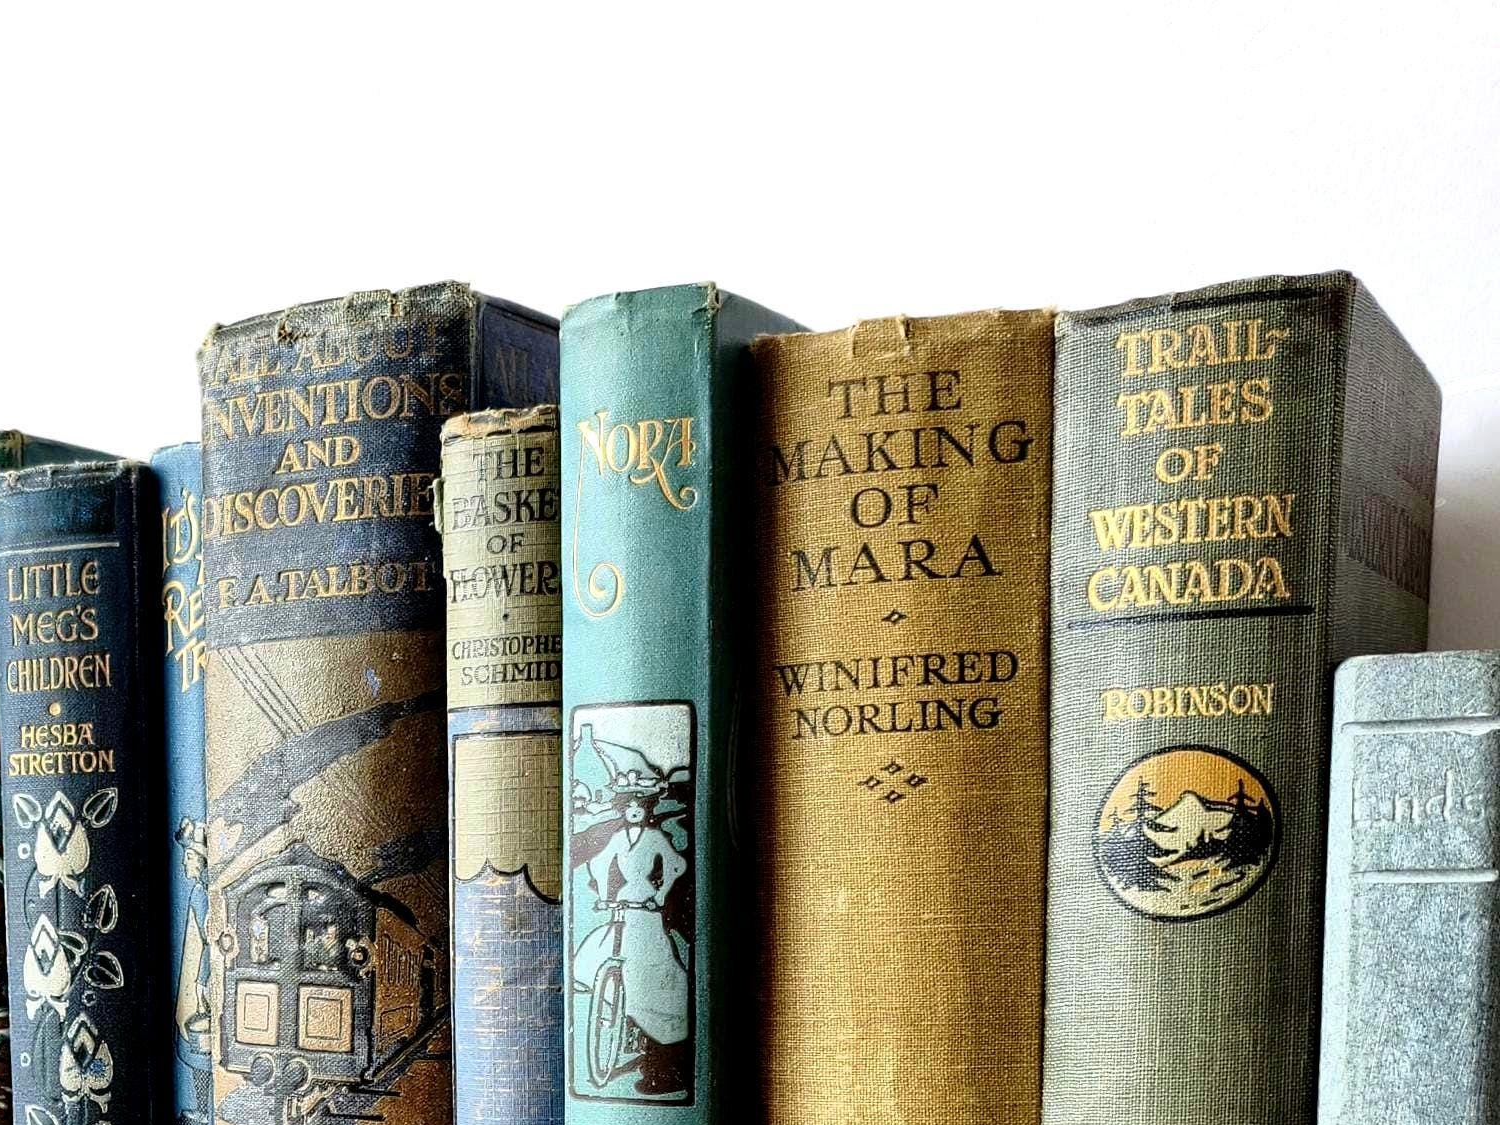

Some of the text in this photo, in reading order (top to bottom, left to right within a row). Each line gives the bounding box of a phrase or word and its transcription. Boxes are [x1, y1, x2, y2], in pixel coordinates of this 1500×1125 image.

[207, 372, 467, 444] NVENTIONS
[827, 369, 963, 420] THE
[1116, 378, 1274, 438] TALES
[274, 435, 362, 476] AND
[472, 446, 545, 483] THE
[770, 419, 1035, 487] MAKING
[1154, 442, 1223, 485] OF
[202, 472, 436, 541] DISCOVERIE
[451, 488, 559, 531] BASKE
[850, 483, 940, 530] OF
[1088, 493, 1296, 553] WESTERN
[485, 532, 526, 556] OF
[791, 534, 1001, 593] MARA
[6, 560, 101, 603] LITTLE
[449, 560, 560, 604] FLOWER
[1087, 555, 1291, 612] CANADA
[11, 604, 100, 648] MEG'S
[451, 633, 562, 661] CHRISTOPHE
[6, 653, 113, 693] CHILDREN
[460, 660, 561, 687] SCHMID
[772, 650, 1020, 697] WINIFRED
[791, 697, 1004, 741] NORLING
[1100, 682, 1275, 722] ROBINSON
[20, 722, 94, 750] HESBA
[8, 750, 117, 777] STRETTON
